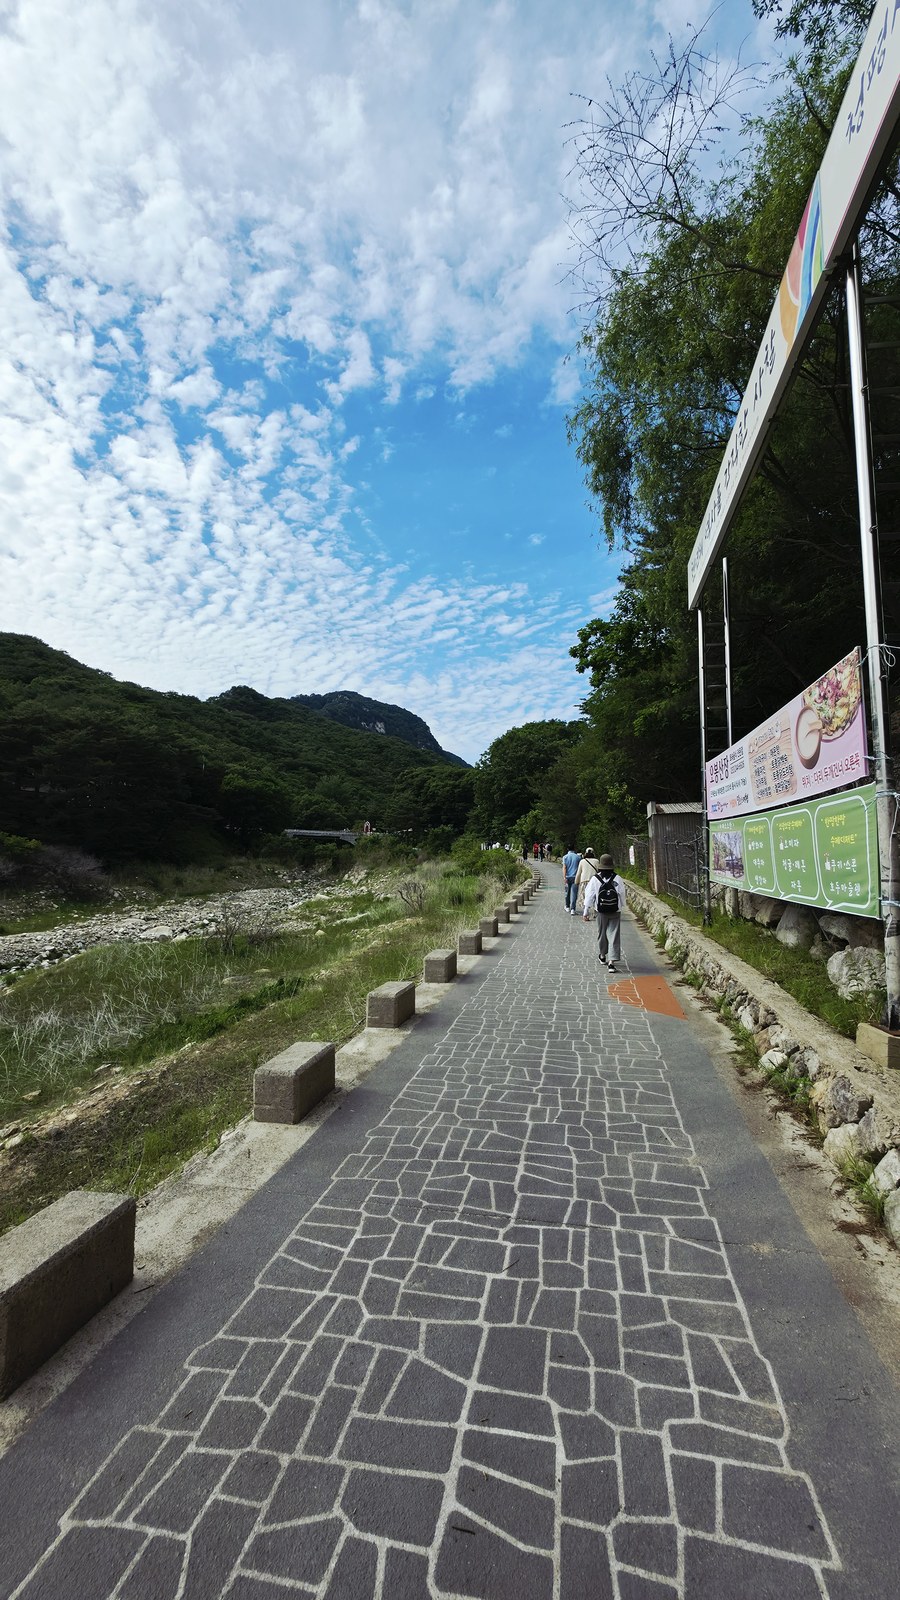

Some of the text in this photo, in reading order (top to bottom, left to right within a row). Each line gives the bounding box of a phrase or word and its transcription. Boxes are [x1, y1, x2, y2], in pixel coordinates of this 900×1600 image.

[724, 408, 749, 490] 간직한
[754, 329, 776, 411] 사찰
[709, 754, 729, 784] 오봉산장
[801, 775, 812, 789] 위치
[814, 769, 824, 786] 다리
[844, 755, 861, 773] 오른쪽
[784, 838, 800, 849] 오미자
[790, 880, 802, 893] 자몽
[829, 881, 861, 897] 호두마들렌
